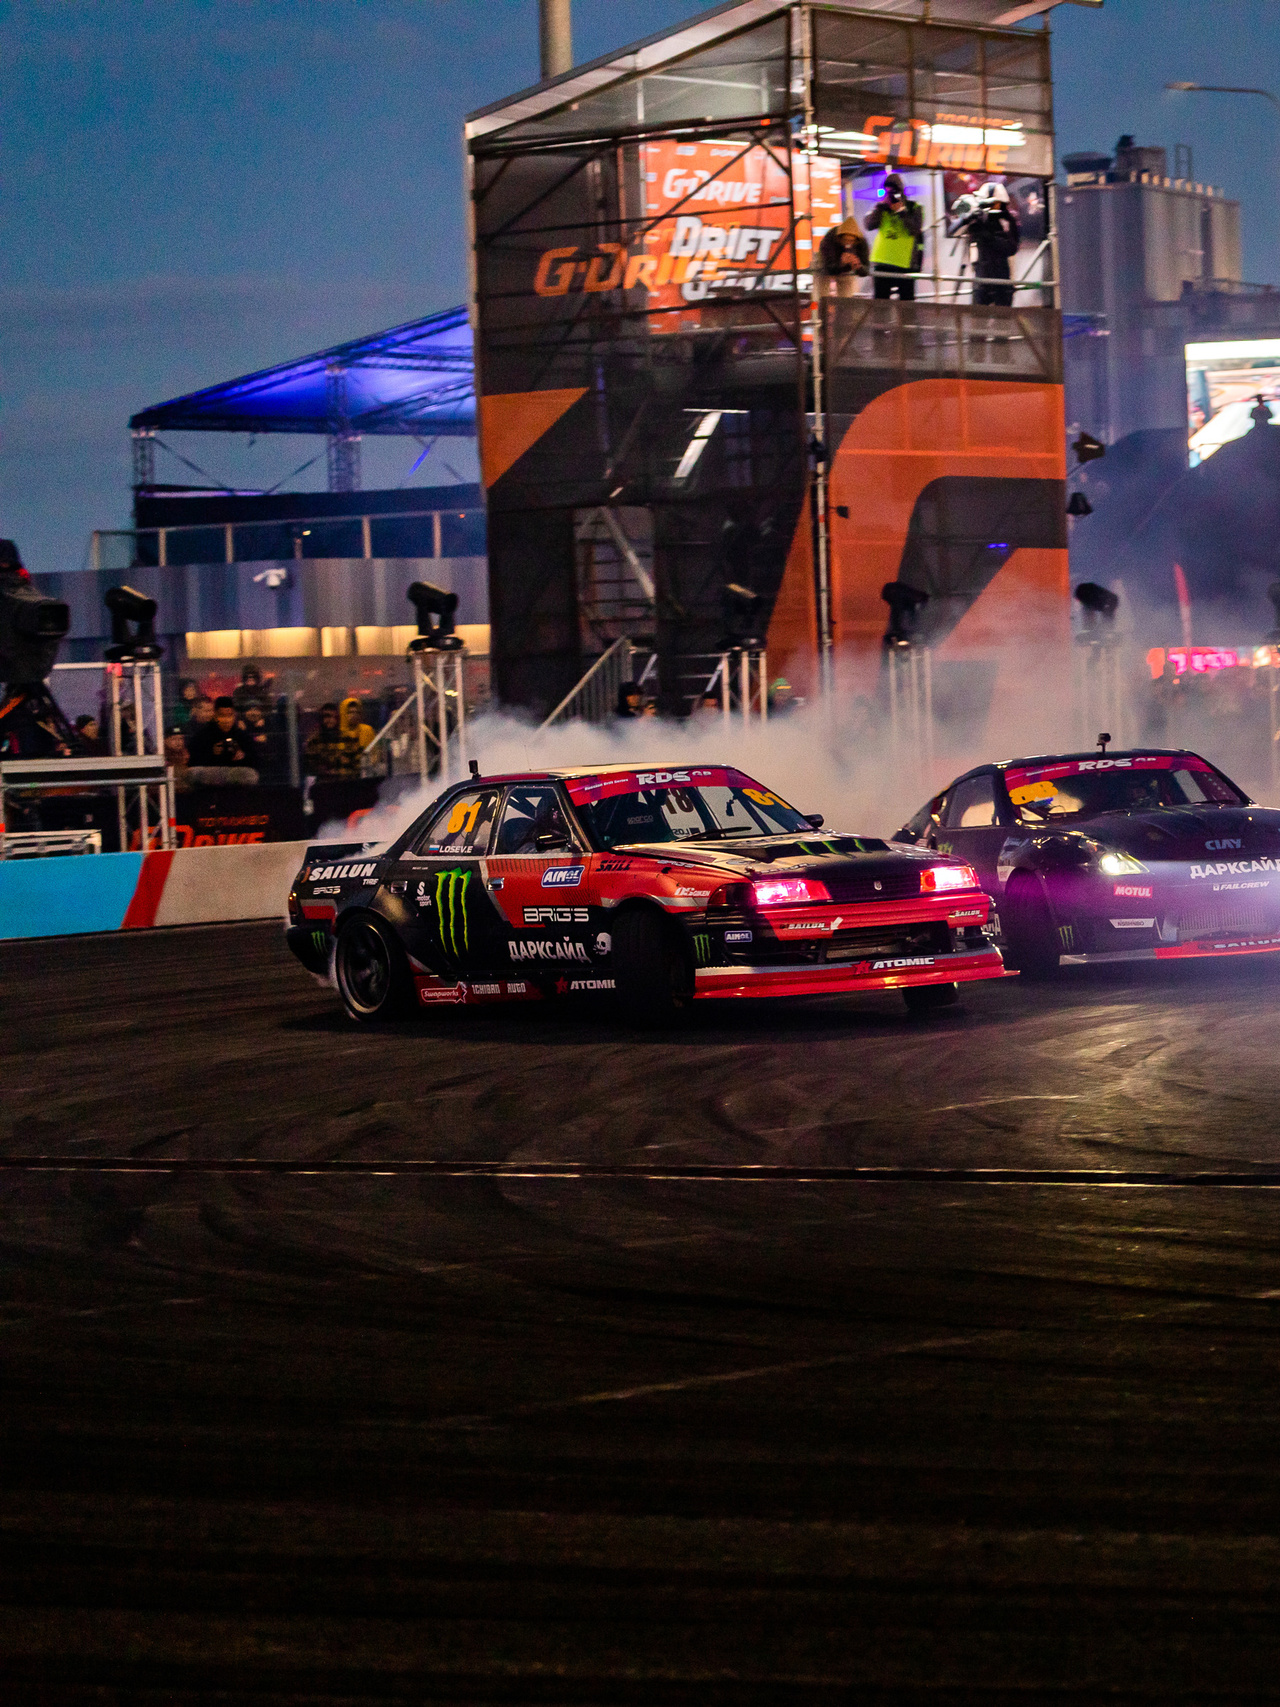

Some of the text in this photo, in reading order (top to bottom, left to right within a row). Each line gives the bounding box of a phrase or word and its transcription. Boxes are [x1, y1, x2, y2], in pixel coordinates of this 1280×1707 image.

[1078, 758, 1133, 771] RDS
[636, 770, 691, 785] RDS
[447, 801, 482, 833] 81
[309, 863, 377, 881] SAILUN
[1115, 886, 1152, 897] MOTUL
[1220, 881, 1270, 891] FAILCREW
[508, 936, 591, 962] ДАРКСАЙД
[872, 957, 935, 970] ATOMIC
